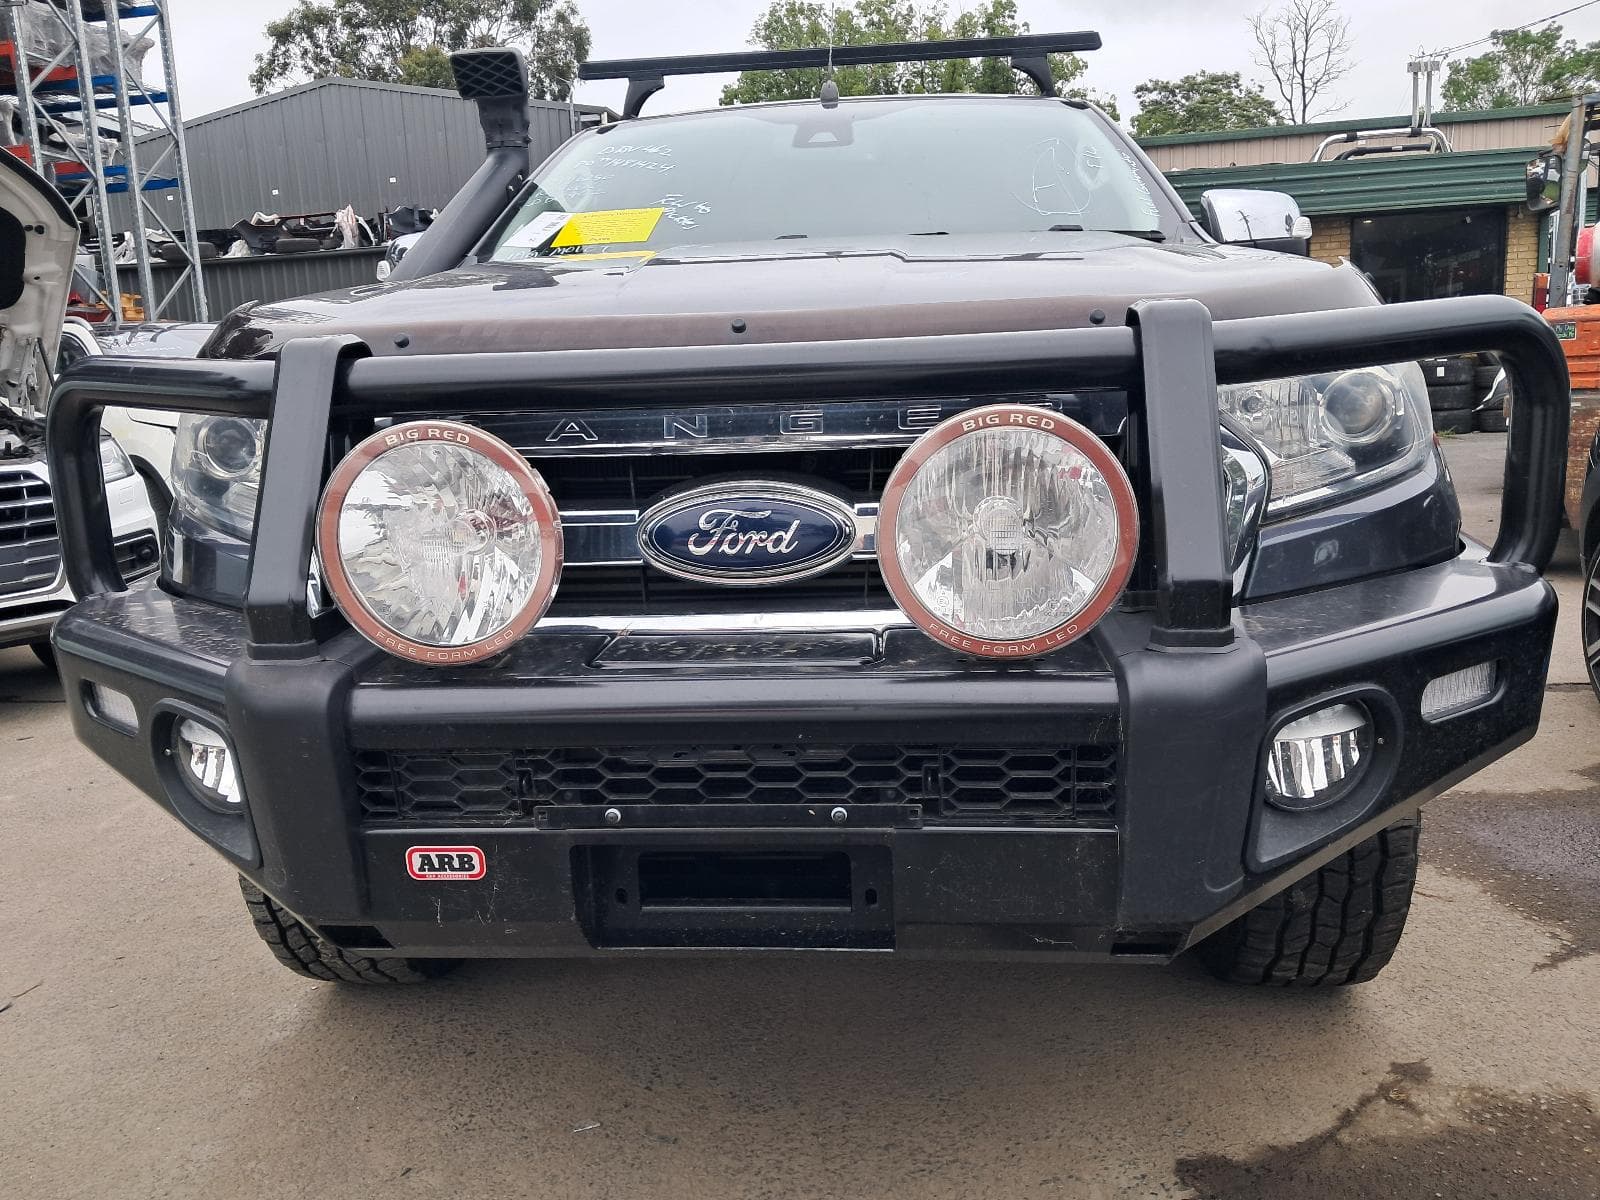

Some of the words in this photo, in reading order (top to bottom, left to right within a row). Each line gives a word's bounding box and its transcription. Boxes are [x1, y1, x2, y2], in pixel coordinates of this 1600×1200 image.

[385, 428, 420, 447] BIG
[427, 427, 471, 445] RED
[545, 401, 1063, 442] ANGE
[960, 414, 1000, 432] BIG
[1009, 413, 1055, 430] RED
[687, 508, 801, 556] Ford
[376, 632, 417, 656] FREE
[427, 647, 477, 660] FORM
[485, 629, 515, 650] LED
[929, 623, 973, 649] FREE
[981, 642, 1036, 654] FORM
[1045, 623, 1079, 645] LED
[417, 853, 476, 873] ARB
